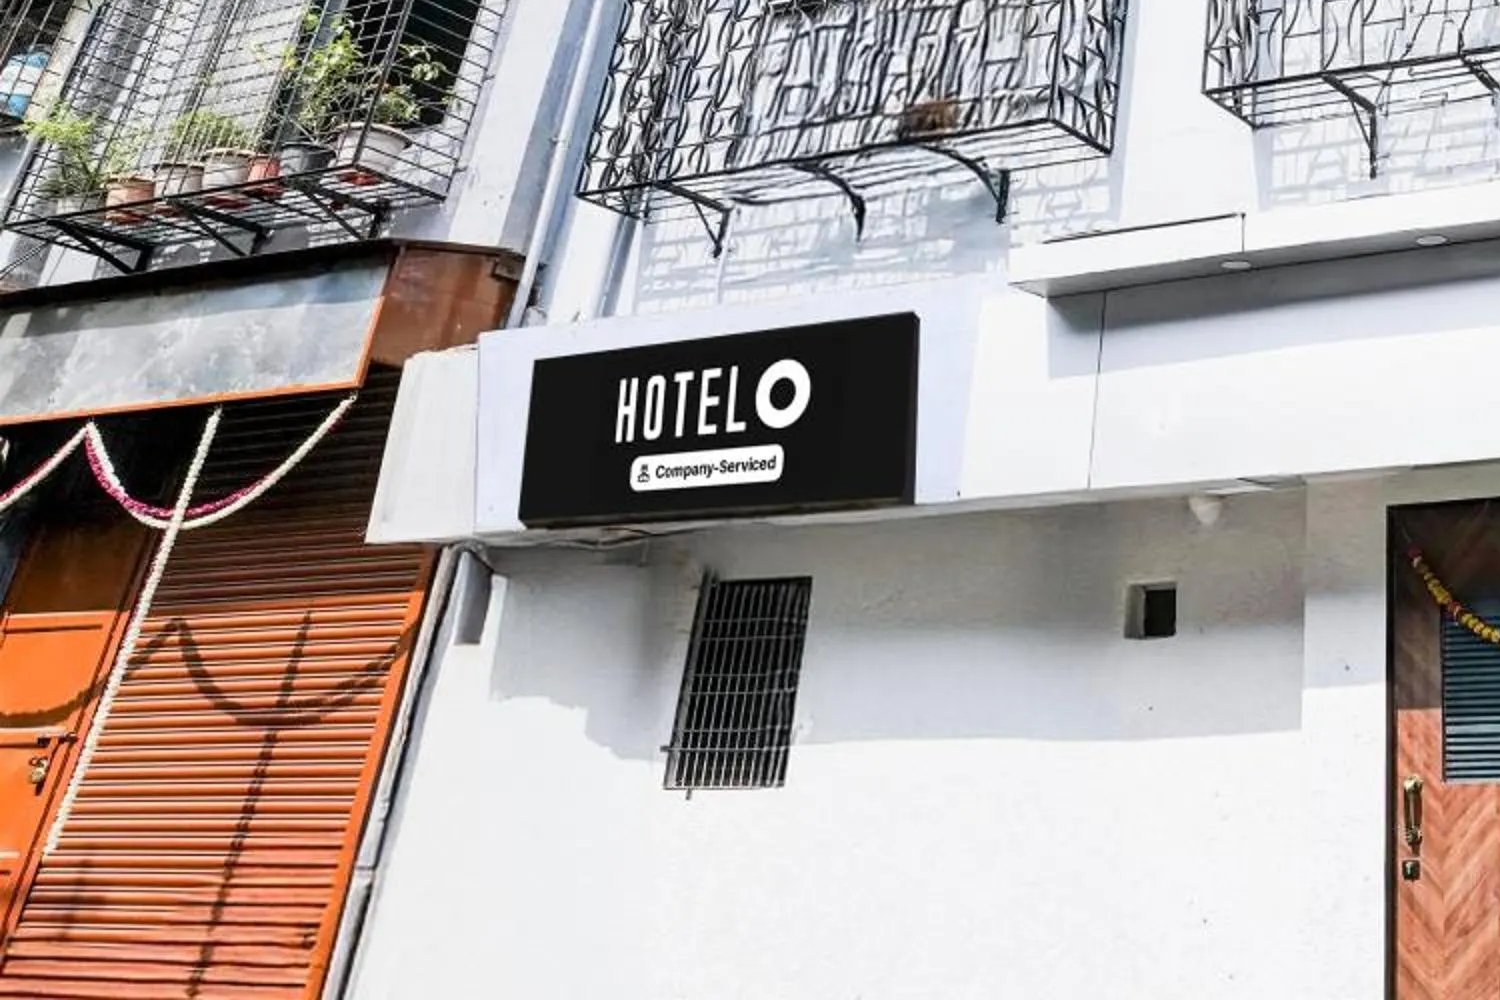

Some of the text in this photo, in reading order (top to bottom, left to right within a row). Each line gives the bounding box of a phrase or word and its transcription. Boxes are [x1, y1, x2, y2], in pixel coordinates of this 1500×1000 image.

[616, 359, 811, 443] HOTEL O
[655, 455, 777, 480] Company-Serviced
